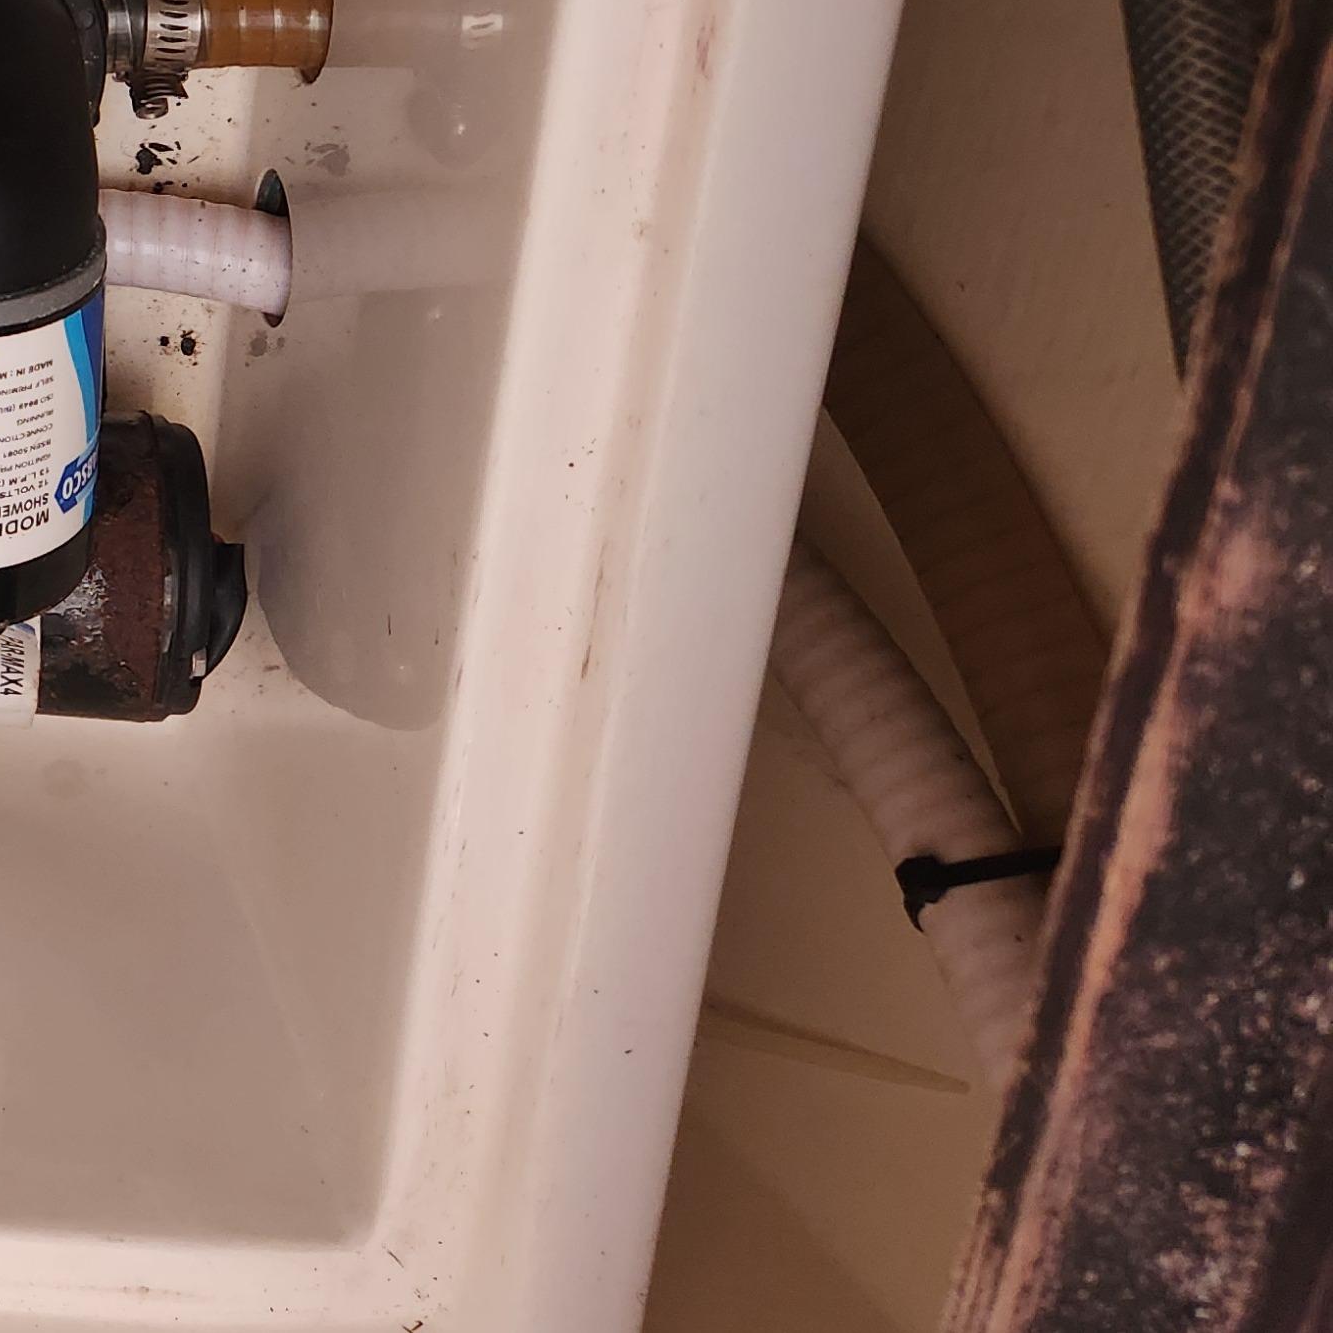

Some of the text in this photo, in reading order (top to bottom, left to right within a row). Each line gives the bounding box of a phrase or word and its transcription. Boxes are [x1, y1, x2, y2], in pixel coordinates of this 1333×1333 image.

[15, 366, 26, 378] IN
[28, 358, 54, 374] MADE
[0, 484, 35, 499] VOLTS
